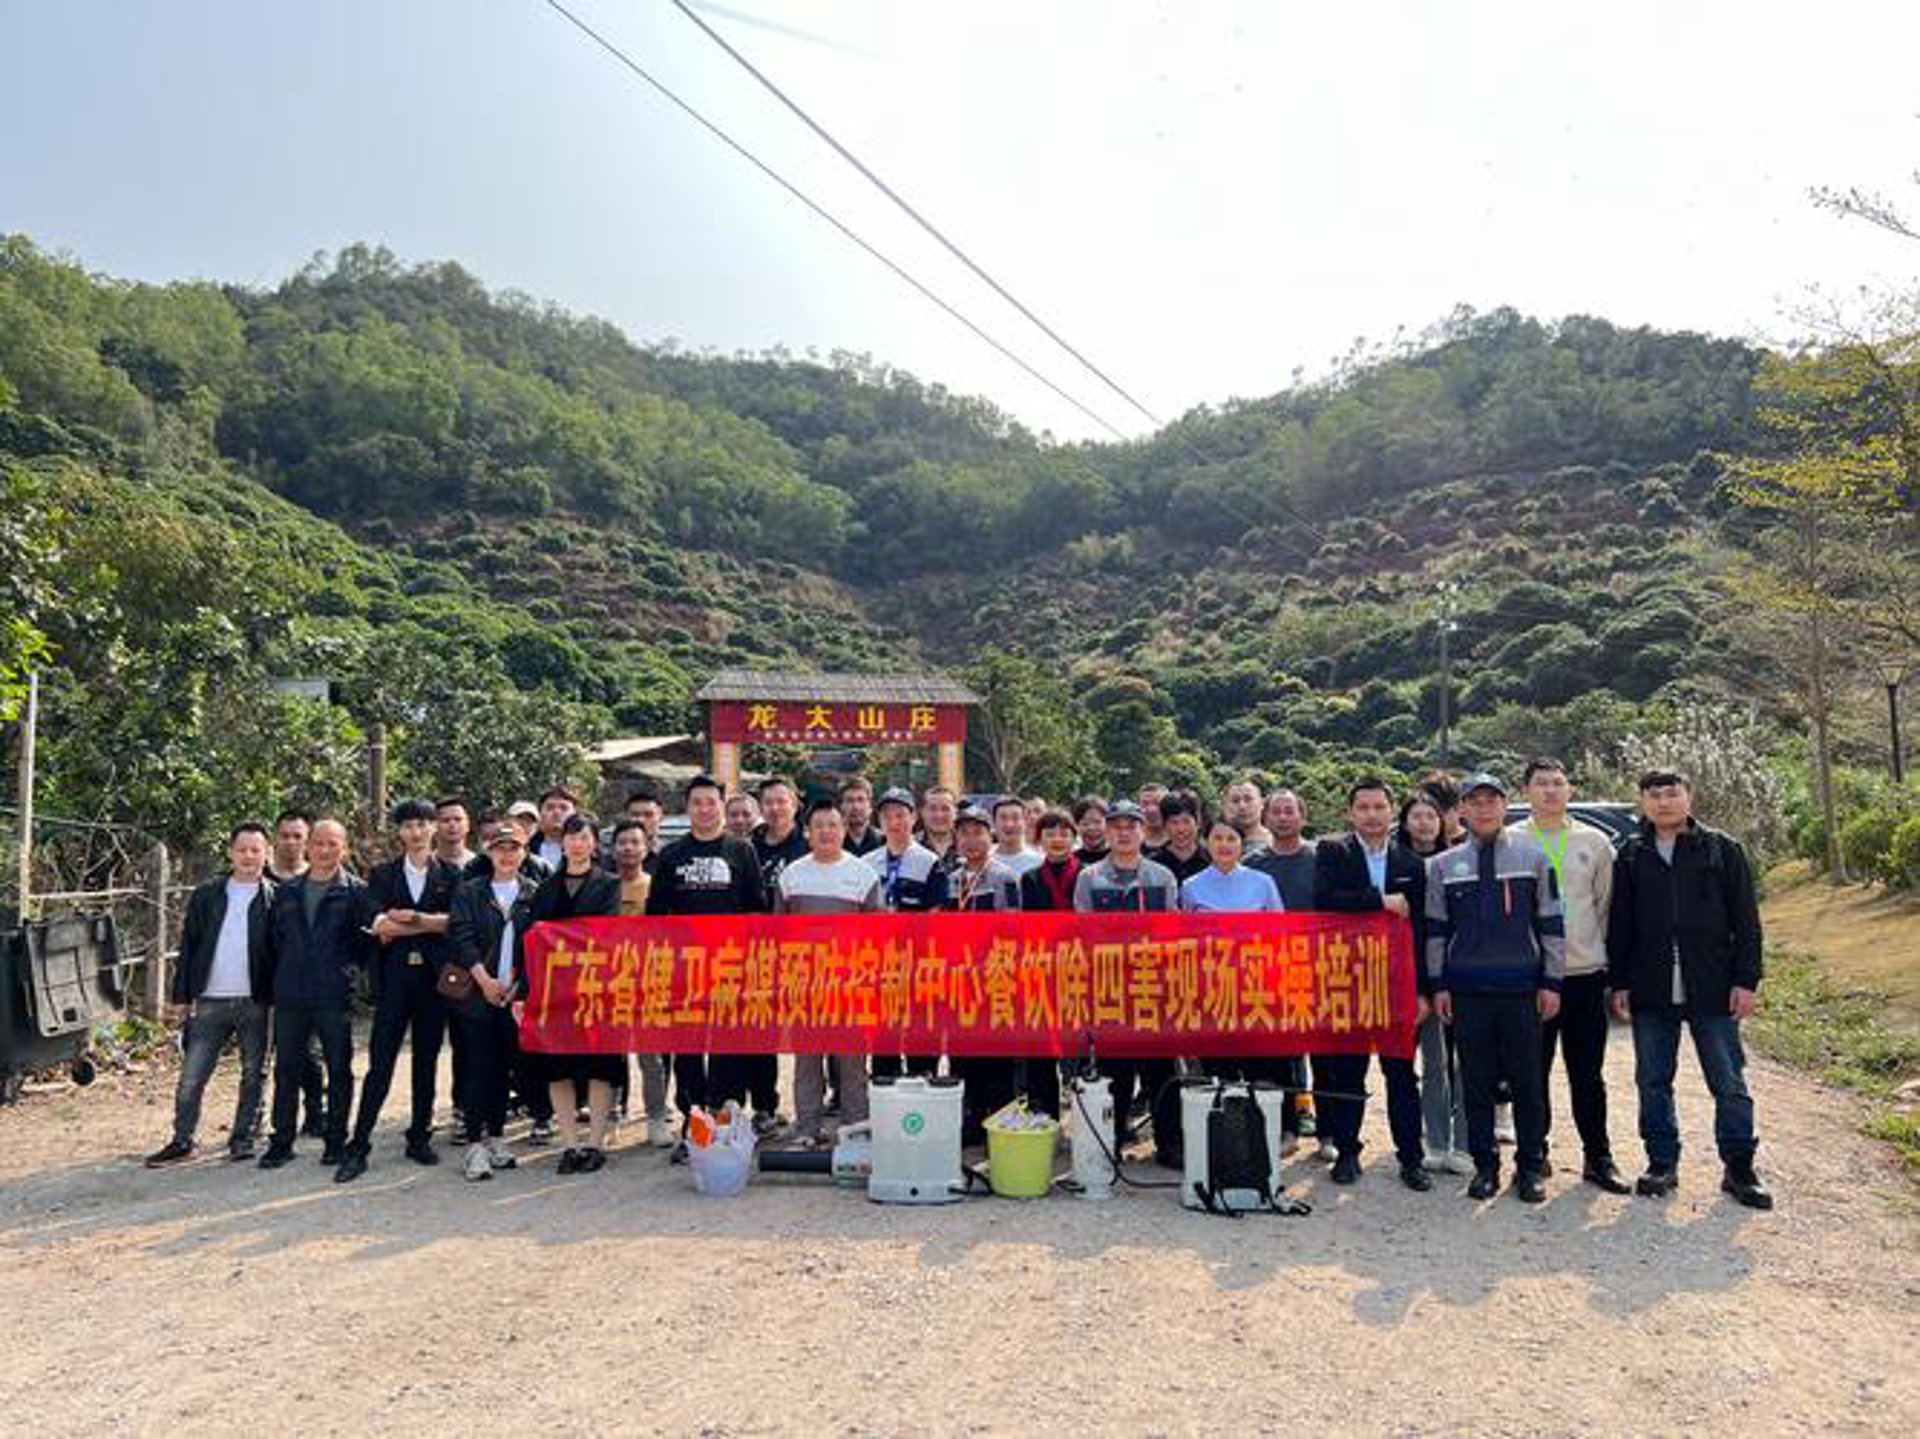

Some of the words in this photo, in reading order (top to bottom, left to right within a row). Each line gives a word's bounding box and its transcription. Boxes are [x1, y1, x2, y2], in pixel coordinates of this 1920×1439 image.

[539, 934, 1390, 1033] 广东省健卫病媒预防控制中心餐饮除四害现场实操培训
